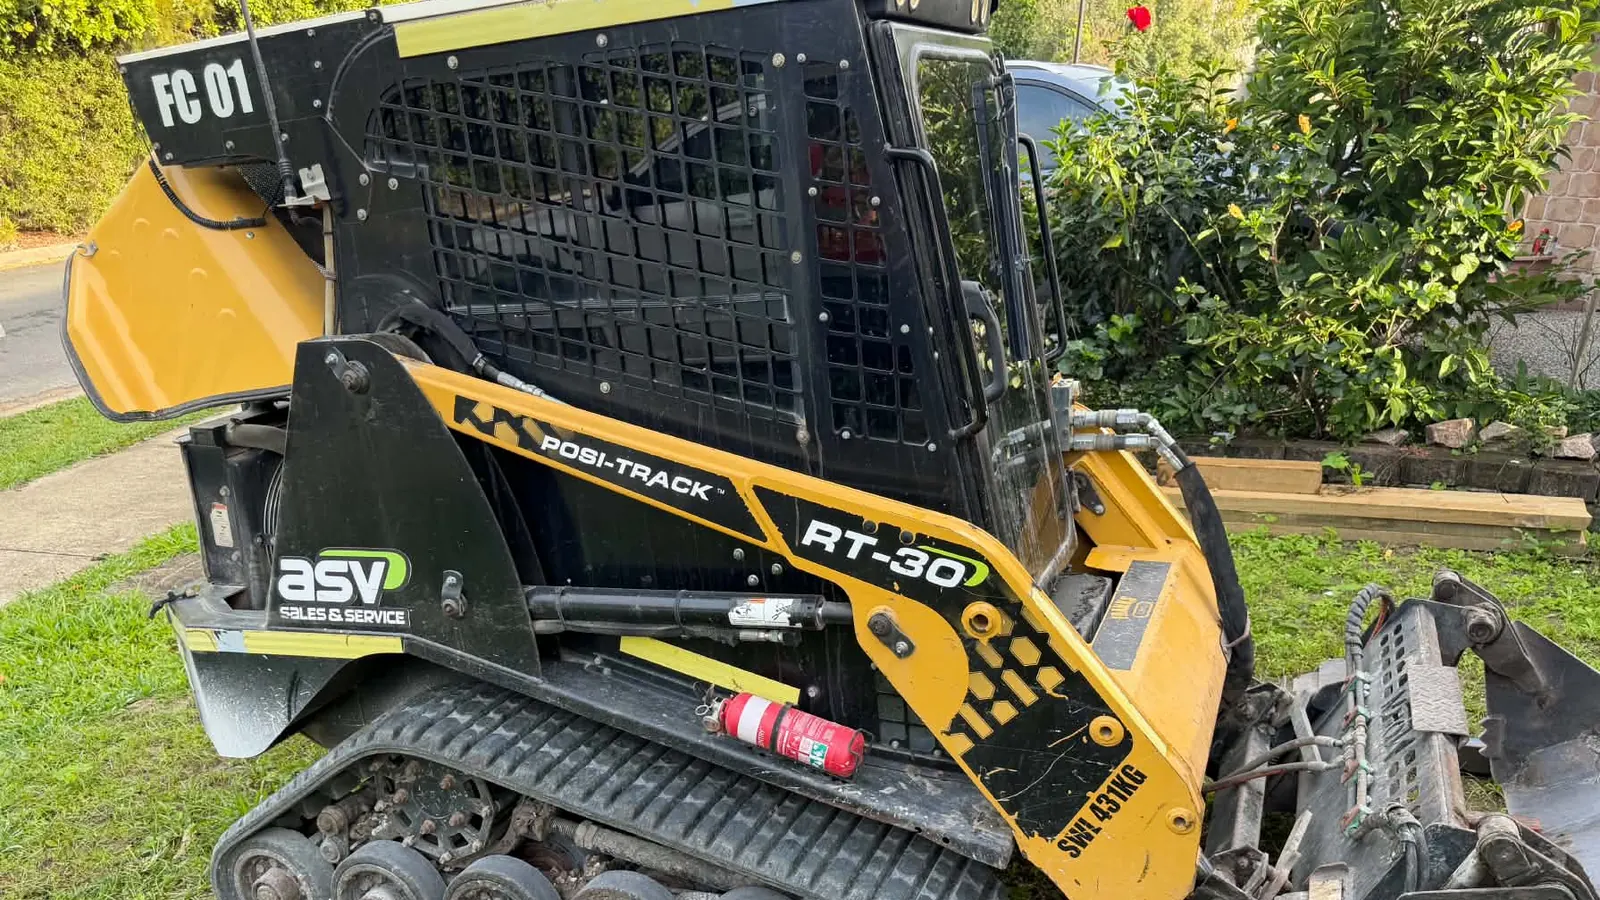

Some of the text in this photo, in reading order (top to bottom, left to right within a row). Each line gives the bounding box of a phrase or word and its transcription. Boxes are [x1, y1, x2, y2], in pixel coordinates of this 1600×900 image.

[151, 58, 254, 128] FC 01
[540, 434, 714, 501] POSI-TRACK
[801, 519, 967, 588] RT-30
[328, 608, 343, 622] &
[344, 608, 406, 625] SERVICE
[1057, 764, 1148, 858] SWL 431KG
